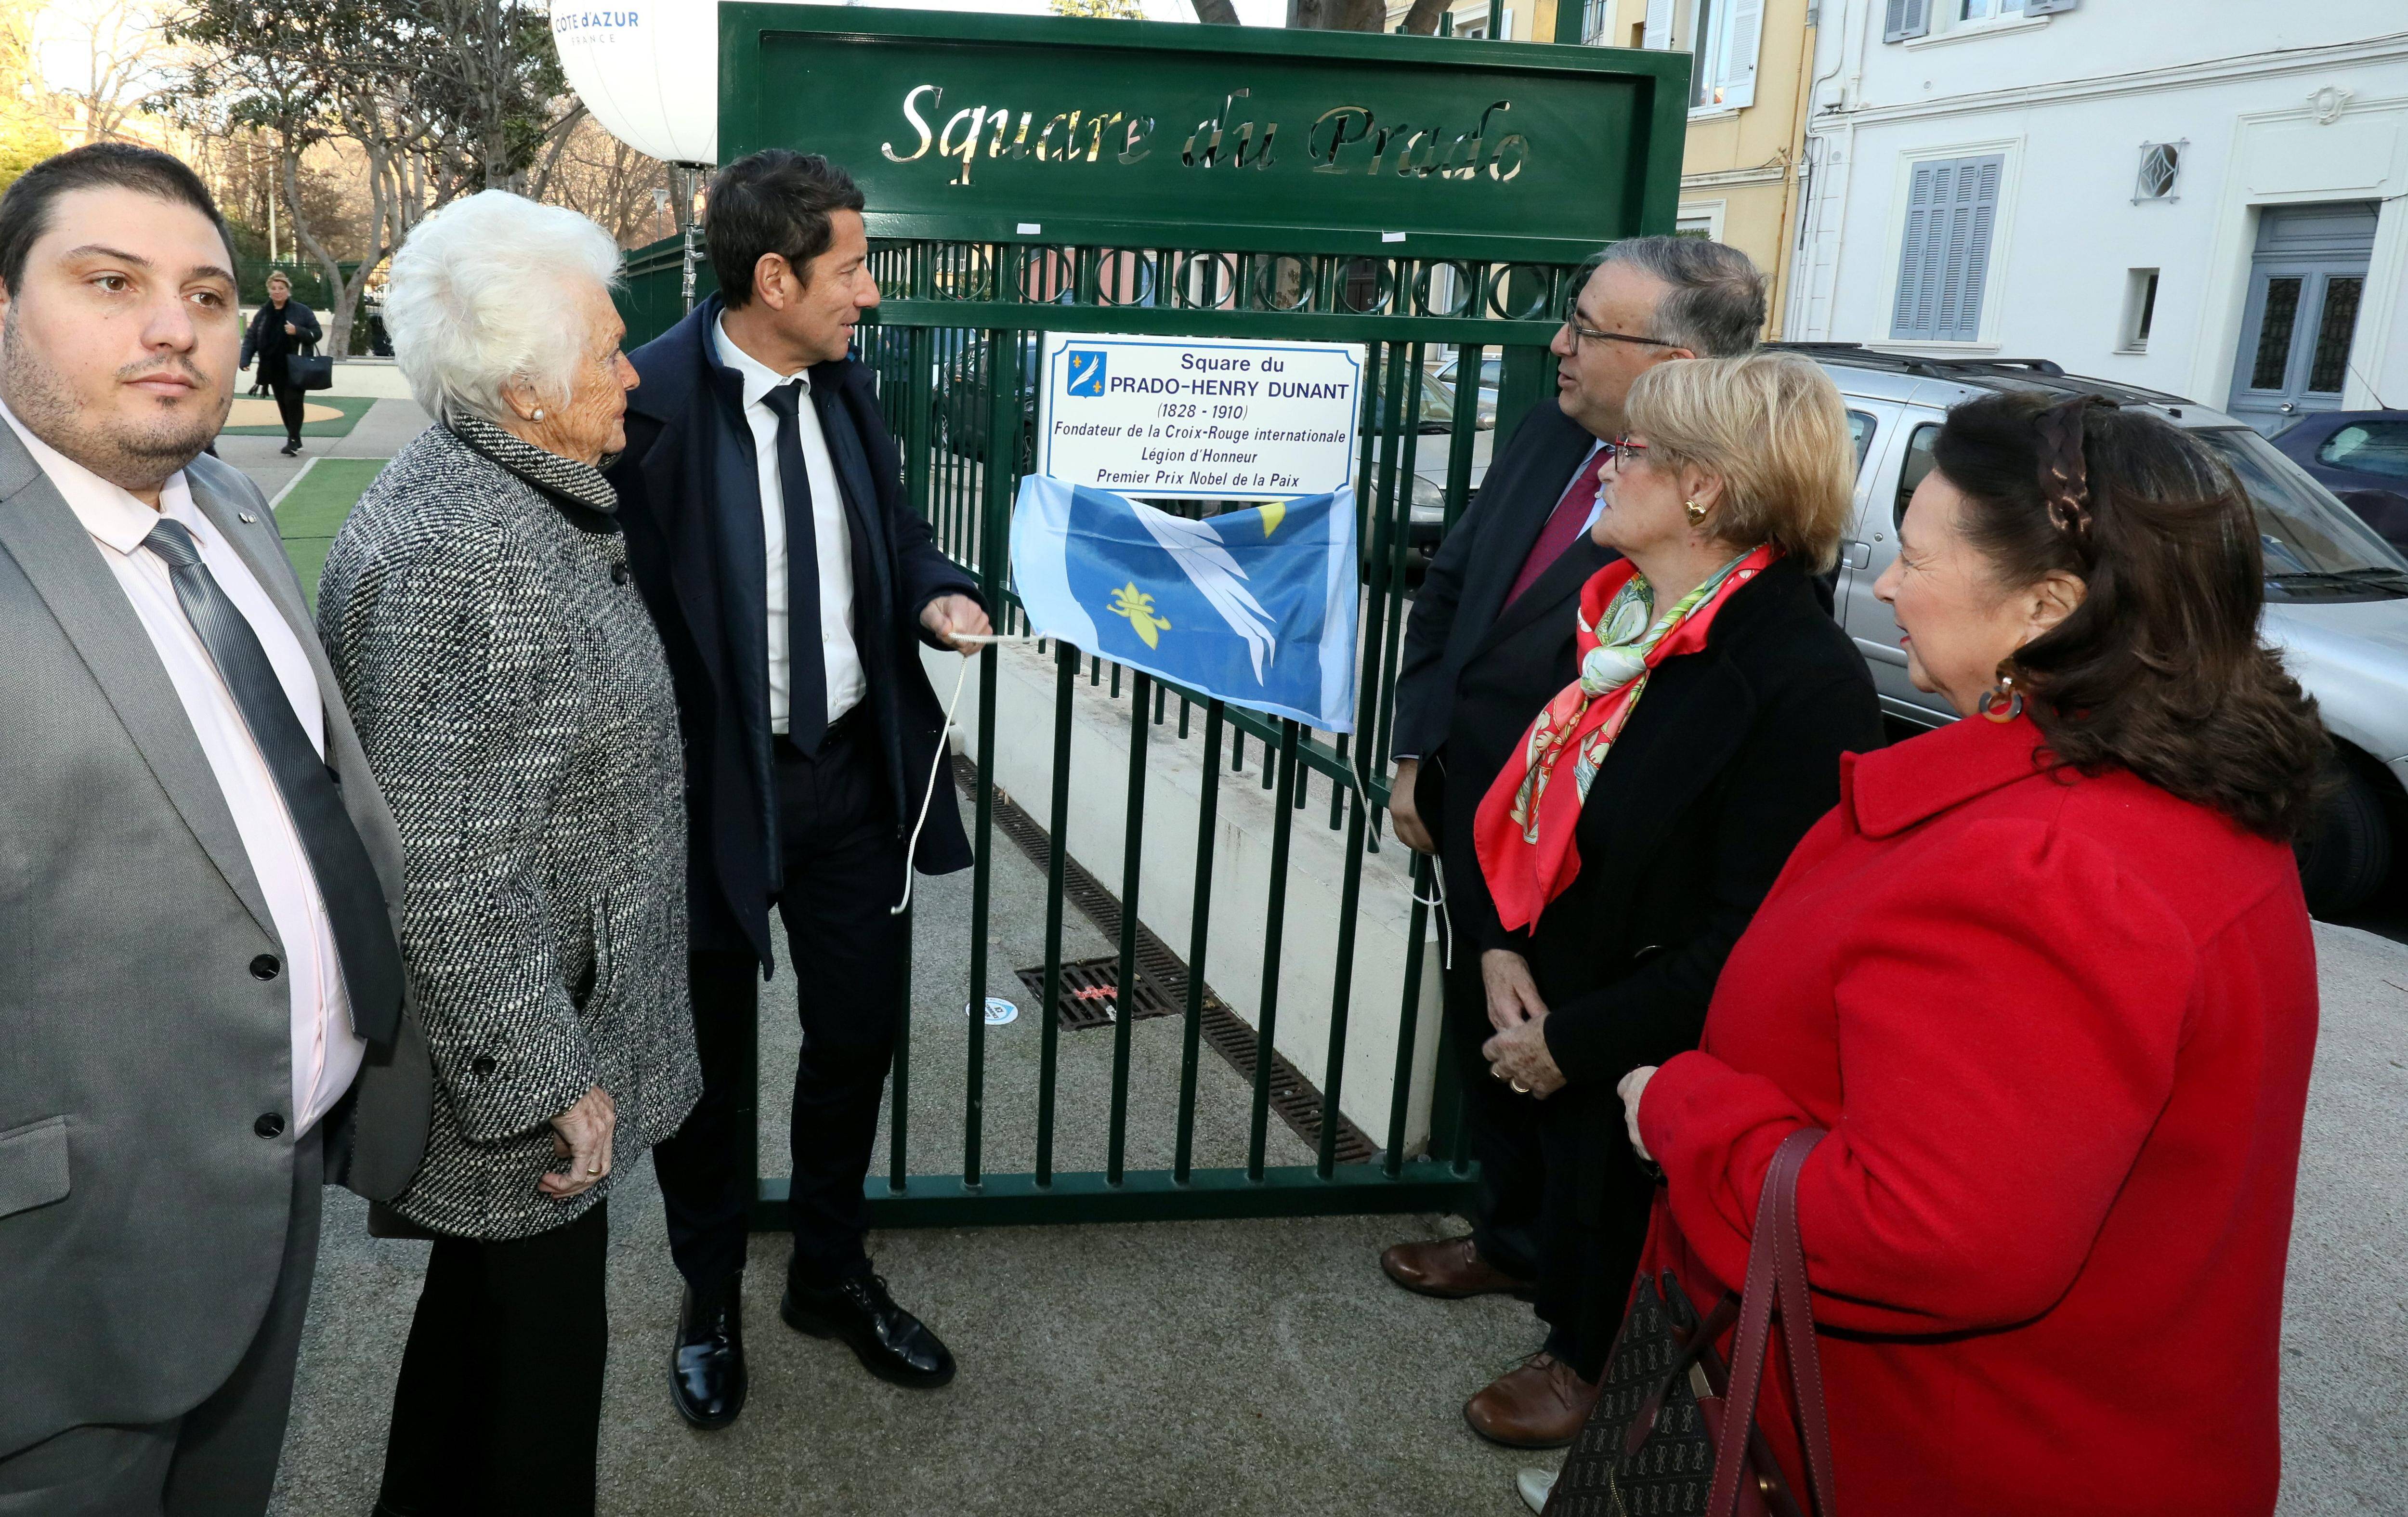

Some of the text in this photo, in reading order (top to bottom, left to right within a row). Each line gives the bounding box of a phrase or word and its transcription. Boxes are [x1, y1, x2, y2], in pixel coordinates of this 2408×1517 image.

[581, 12, 639, 27] d'AZUR
[572, 34, 615, 46] FRANCE
[881, 84, 1529, 186] Square du Prado
[1181, 353, 1284, 373] Square du
[1111, 377, 1349, 399] PRADO-HENRY DUNANT
[1157, 404, 1196, 418] (1828
[1213, 405, 1248, 419] 1910)
[1054, 421, 1346, 444] Fondateur de la Croix-Rouge internationale
[1141, 446, 1257, 465] Légion d'Honneur
[1097, 469, 1299, 487] Premier Prix Nobel de la Paix
